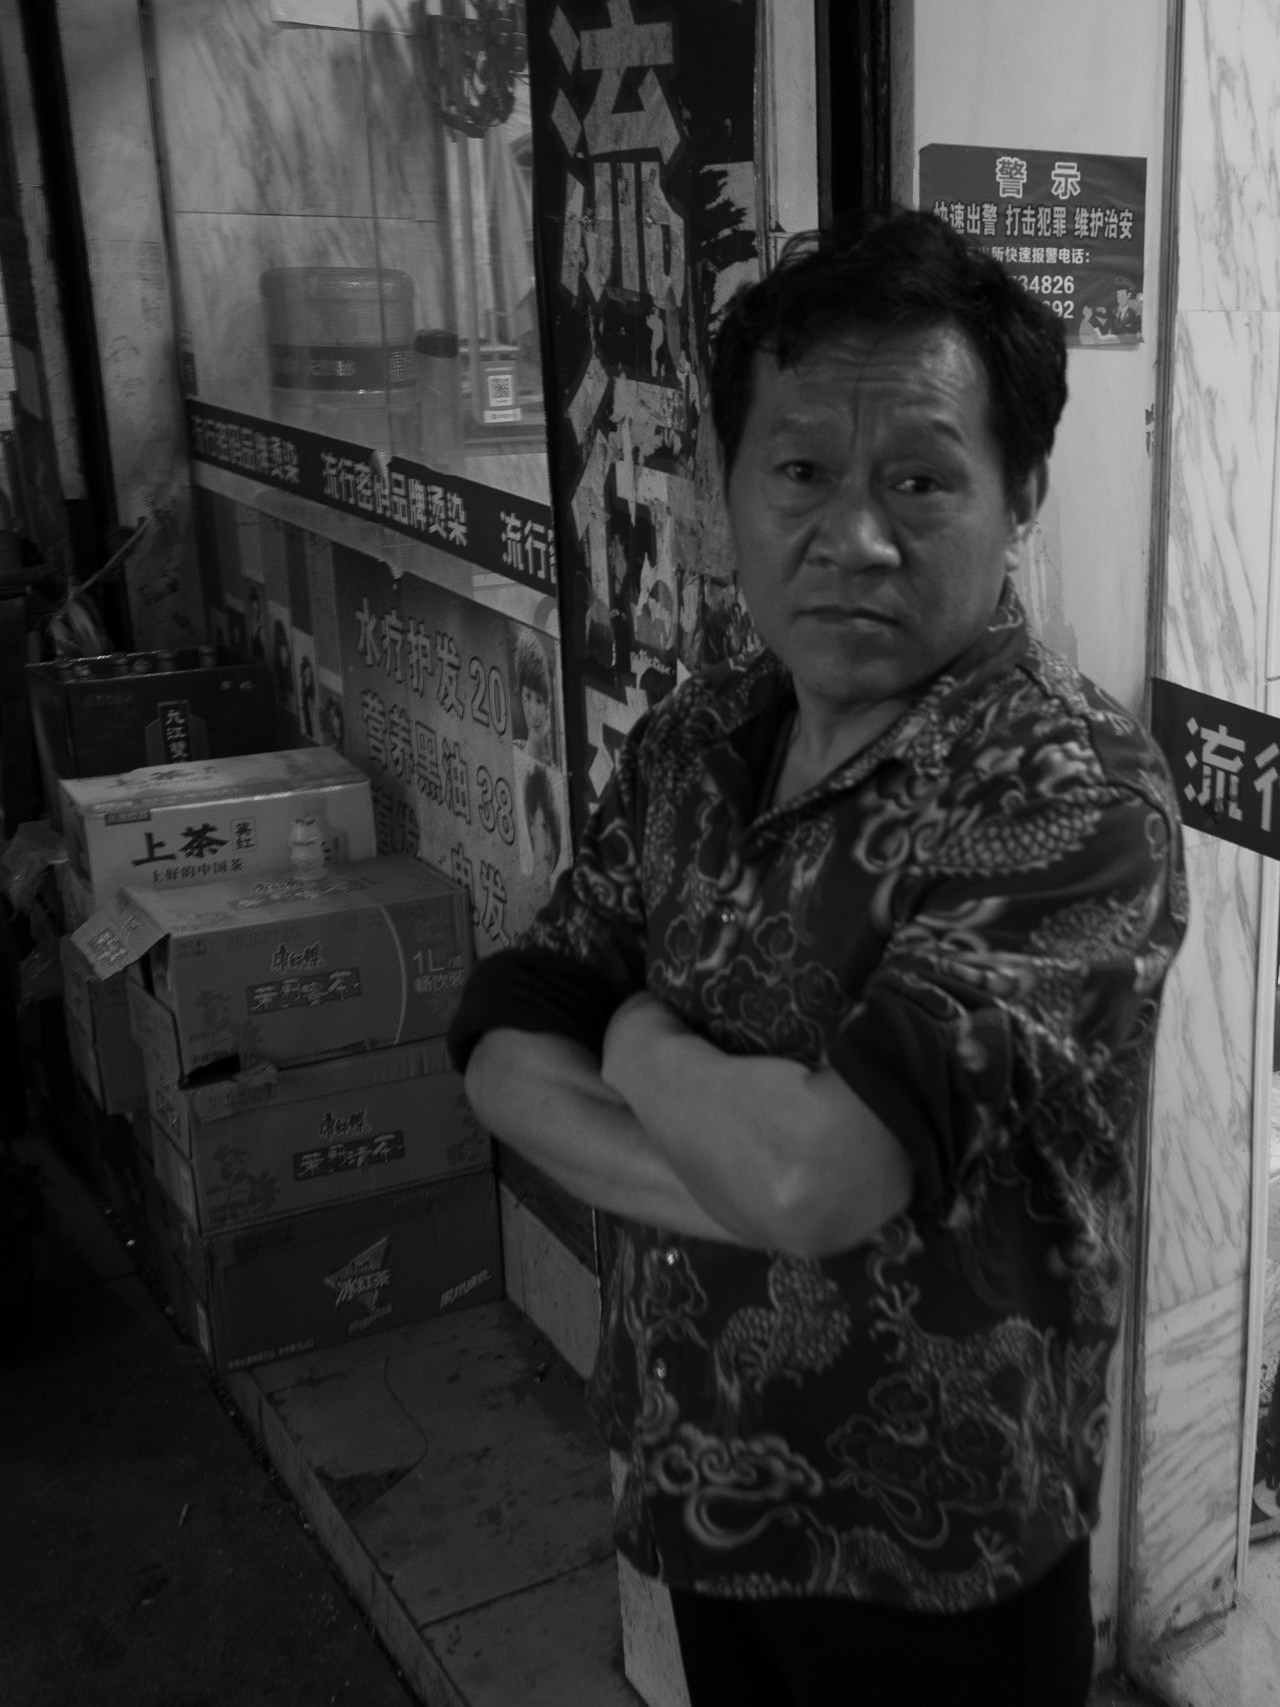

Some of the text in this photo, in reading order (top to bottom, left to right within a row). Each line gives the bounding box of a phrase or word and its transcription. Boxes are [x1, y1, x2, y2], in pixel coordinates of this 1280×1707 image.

[1005, 203, 1068, 238] 打击犯罪
[1074, 206, 1133, 240] 维护治安
[1007, 274, 1075, 295] 34826
